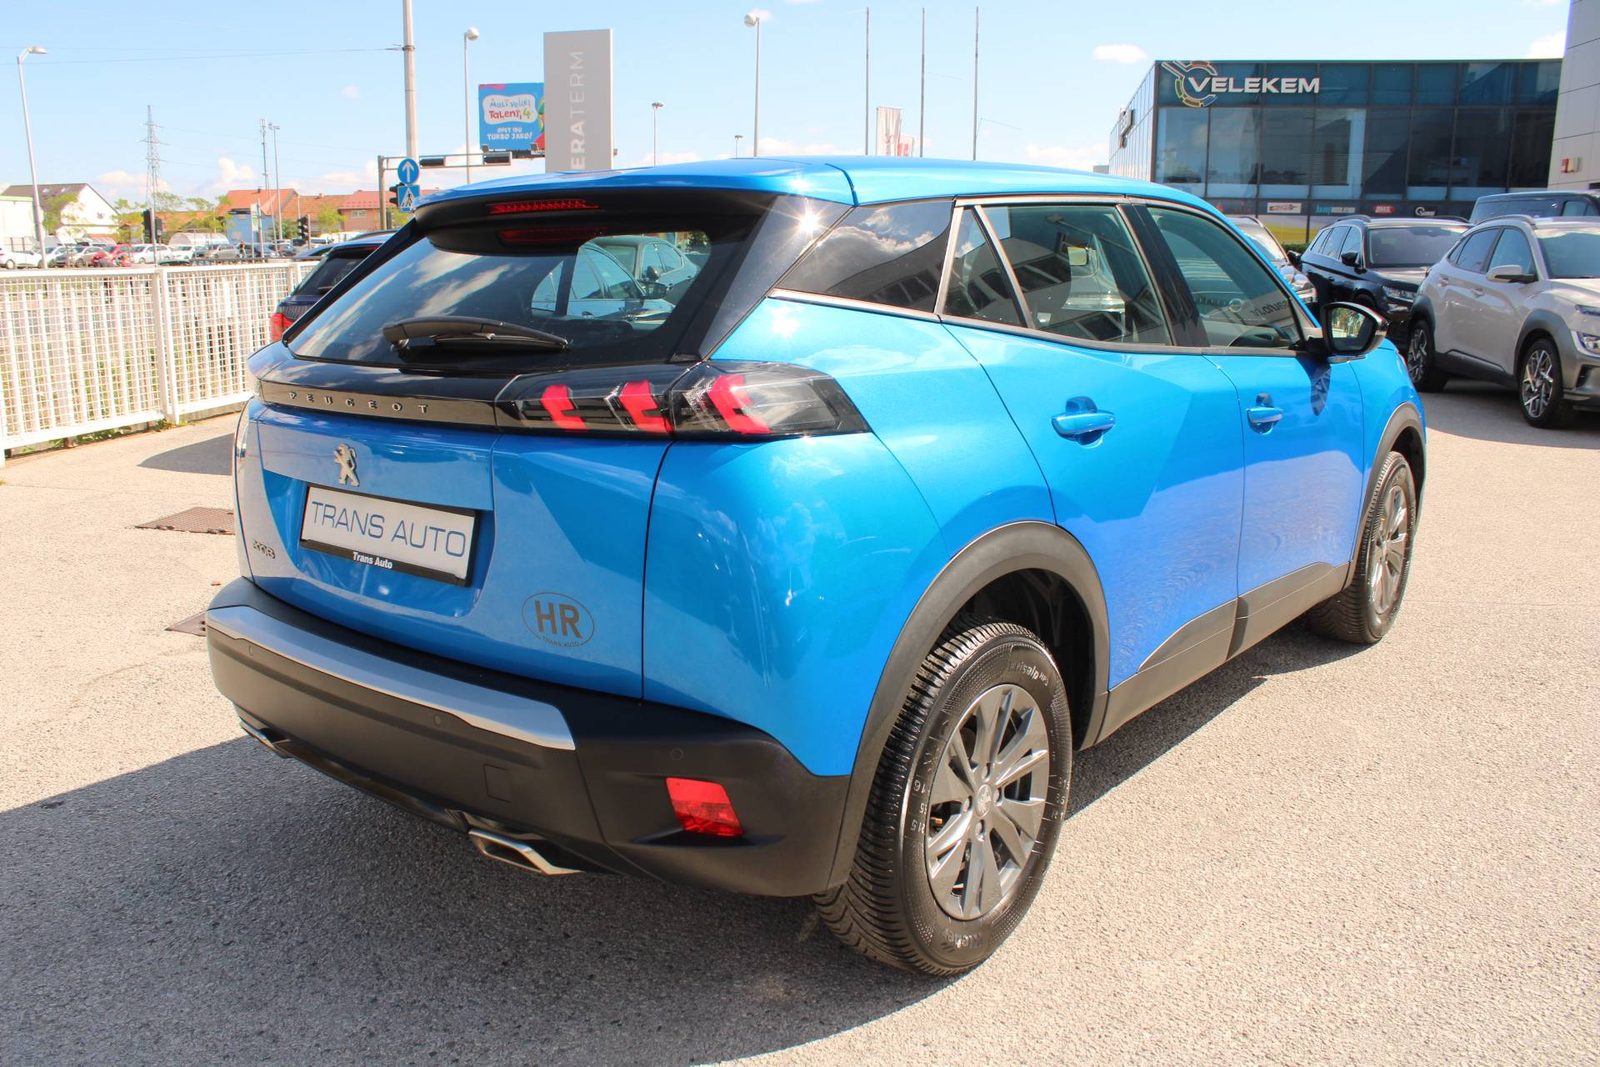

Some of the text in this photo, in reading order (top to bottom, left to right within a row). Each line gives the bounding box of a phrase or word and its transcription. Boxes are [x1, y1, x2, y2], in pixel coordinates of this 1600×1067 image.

[1188, 77, 1320, 94] VELEKEM
[288, 391, 429, 414] PEUGEOT
[312, 500, 466, 558] TRANS AUTO
[352, 551, 393, 570] Trans Auto
[535, 599, 583, 640] HR
